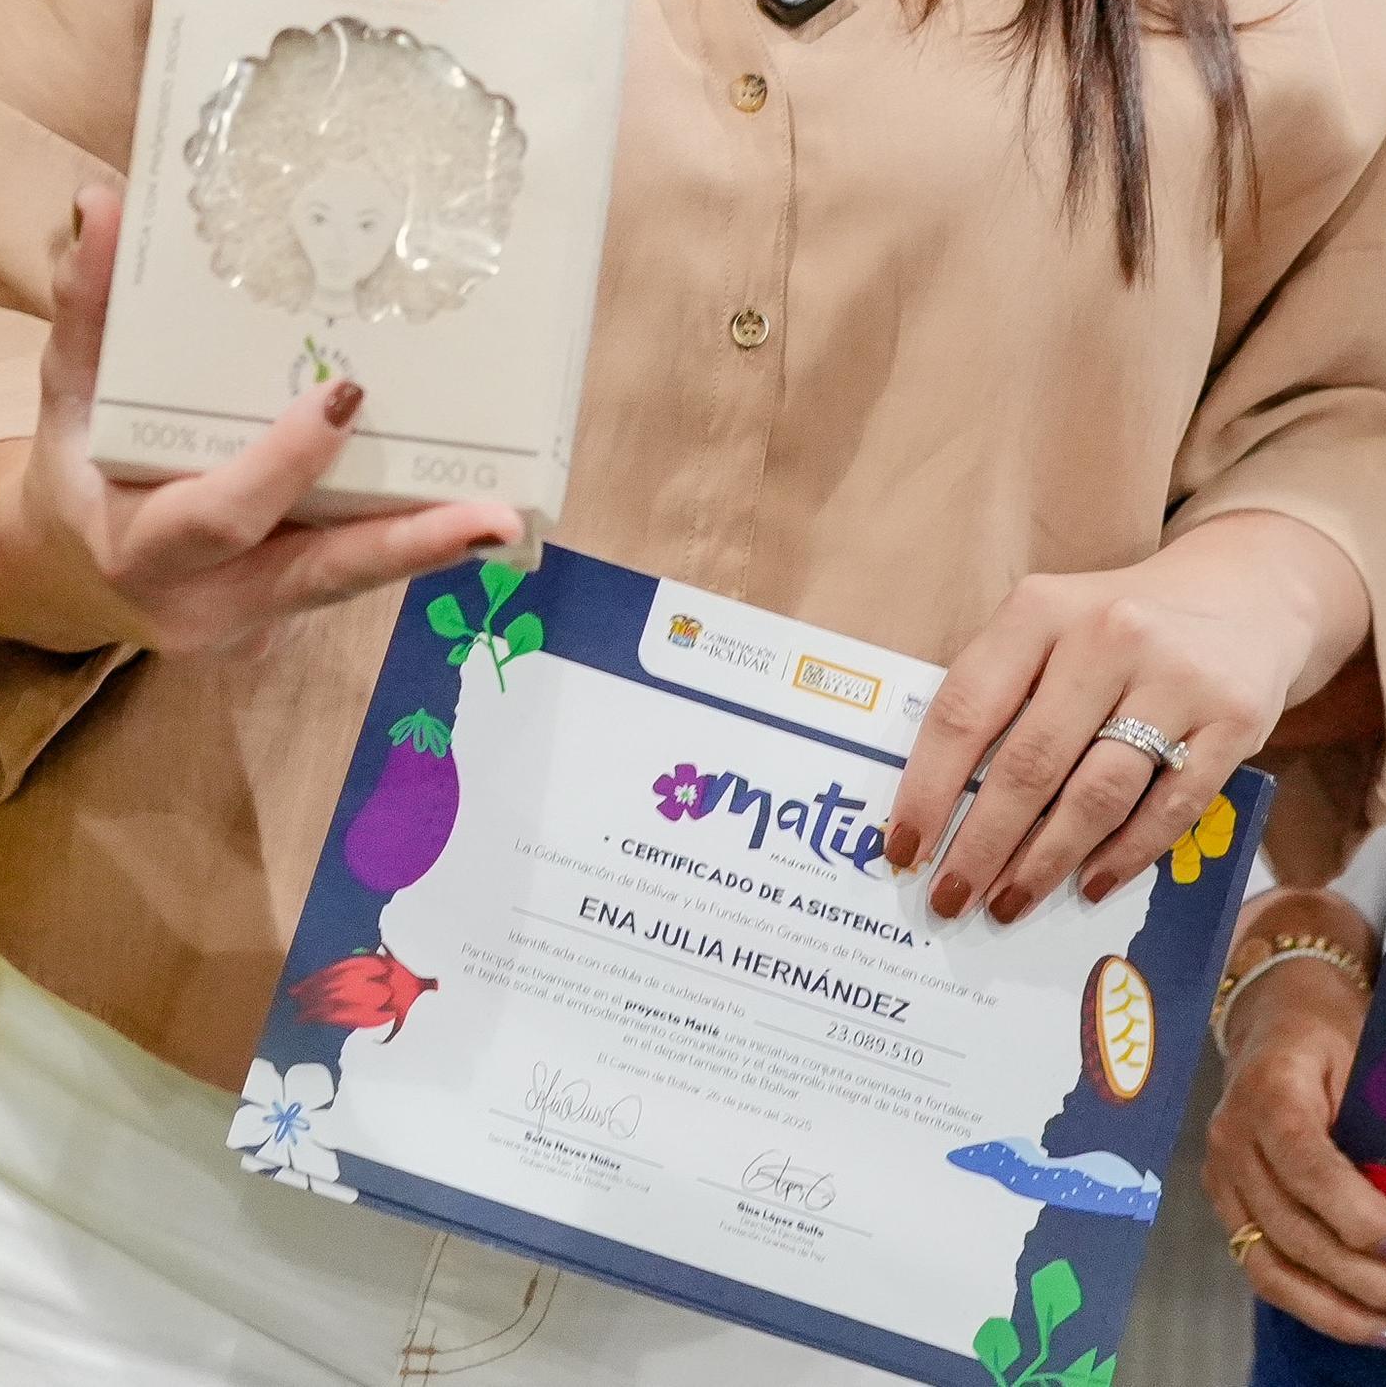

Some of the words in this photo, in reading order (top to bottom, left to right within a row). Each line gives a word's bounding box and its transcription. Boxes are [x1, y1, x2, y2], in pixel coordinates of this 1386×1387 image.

[129, 419, 197, 453] 100%
[414, 454, 467, 483] 500
[473, 462, 498, 490] G
[620, 838, 753, 893] CERTIFICADO
[758, 884, 783, 903] DE
[789, 894, 915, 947] ASISTENCIA
[578, 896, 638, 933] ENA
[643, 916, 726, 962] JULIA
[731, 941, 911, 1022] HERNÁNDEZ
[624, 999, 679, 1026] proyecto
